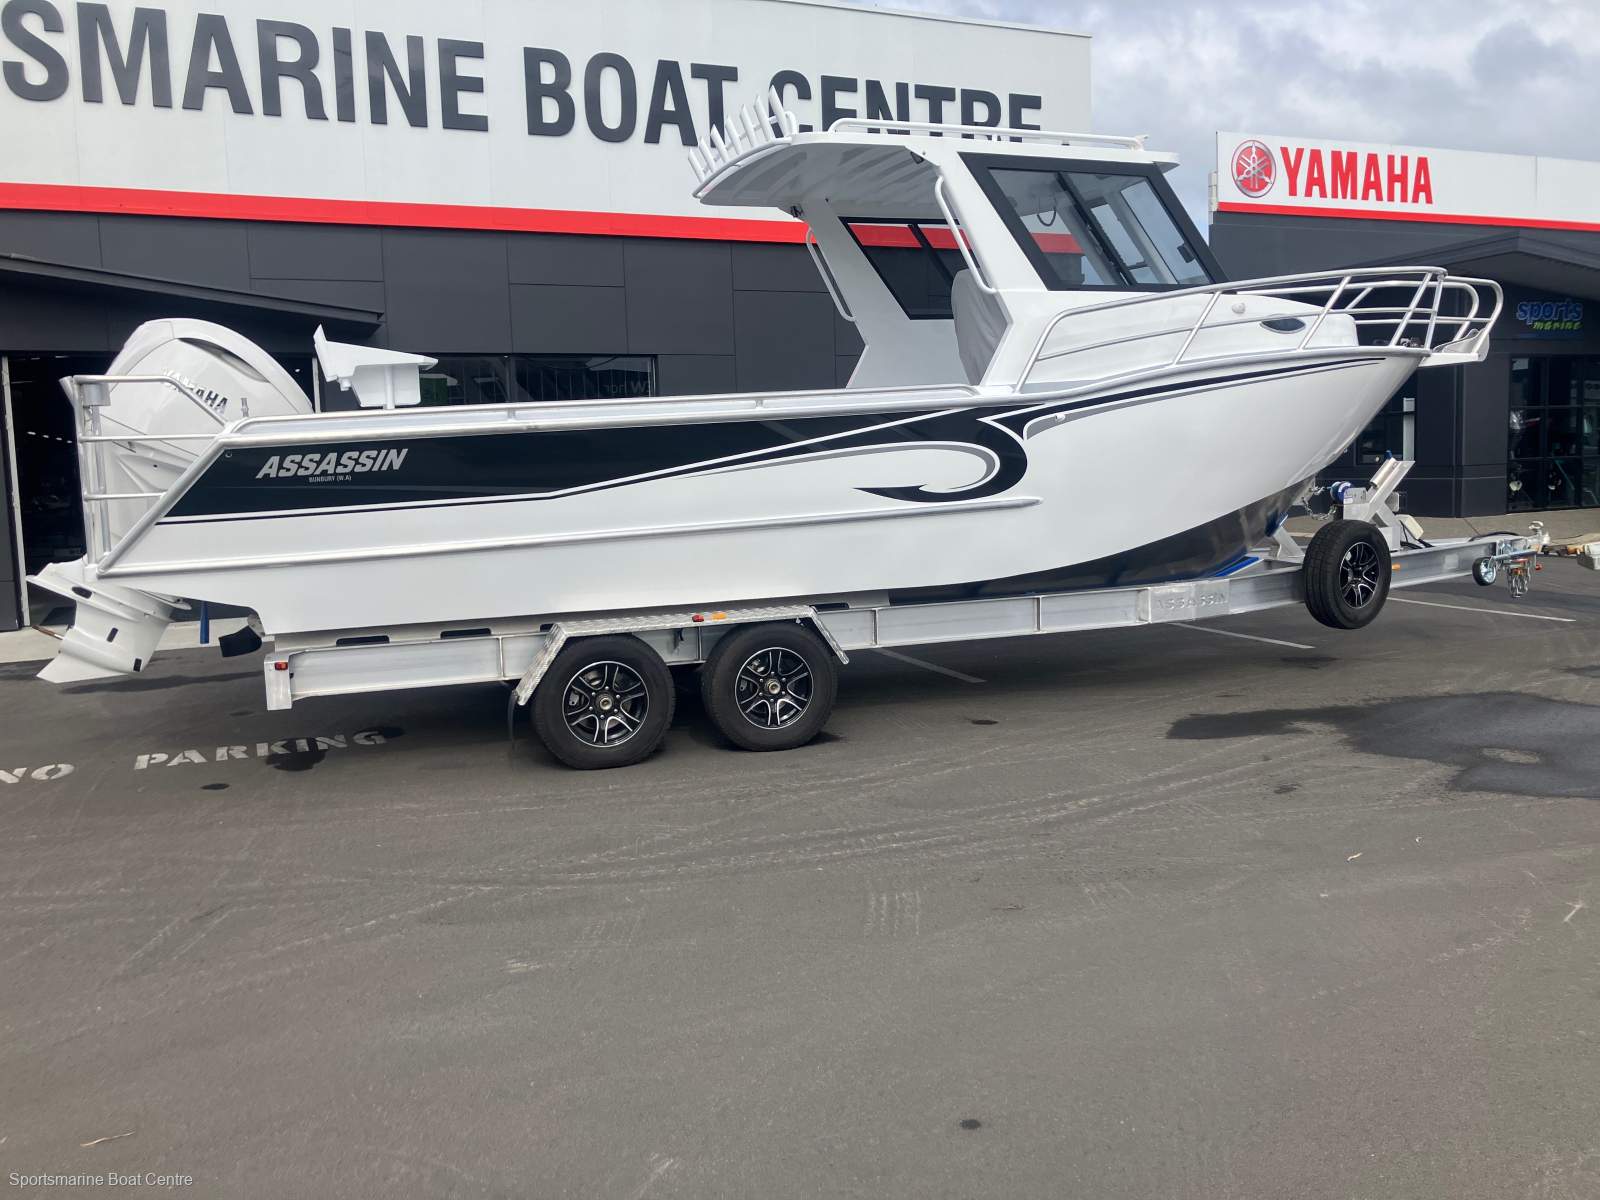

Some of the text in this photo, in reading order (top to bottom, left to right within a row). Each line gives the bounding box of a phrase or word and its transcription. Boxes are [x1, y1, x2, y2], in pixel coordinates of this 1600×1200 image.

[1, 0, 1042, 148] SMARINE BOAT CENTRE
[1279, 146, 1434, 205] YAMAHA
[1516, 299, 1583, 325] sports
[1532, 320, 1582, 331] marine
[255, 448, 409, 479] ASSASSIN
[133, 730, 388, 770] PARKING
